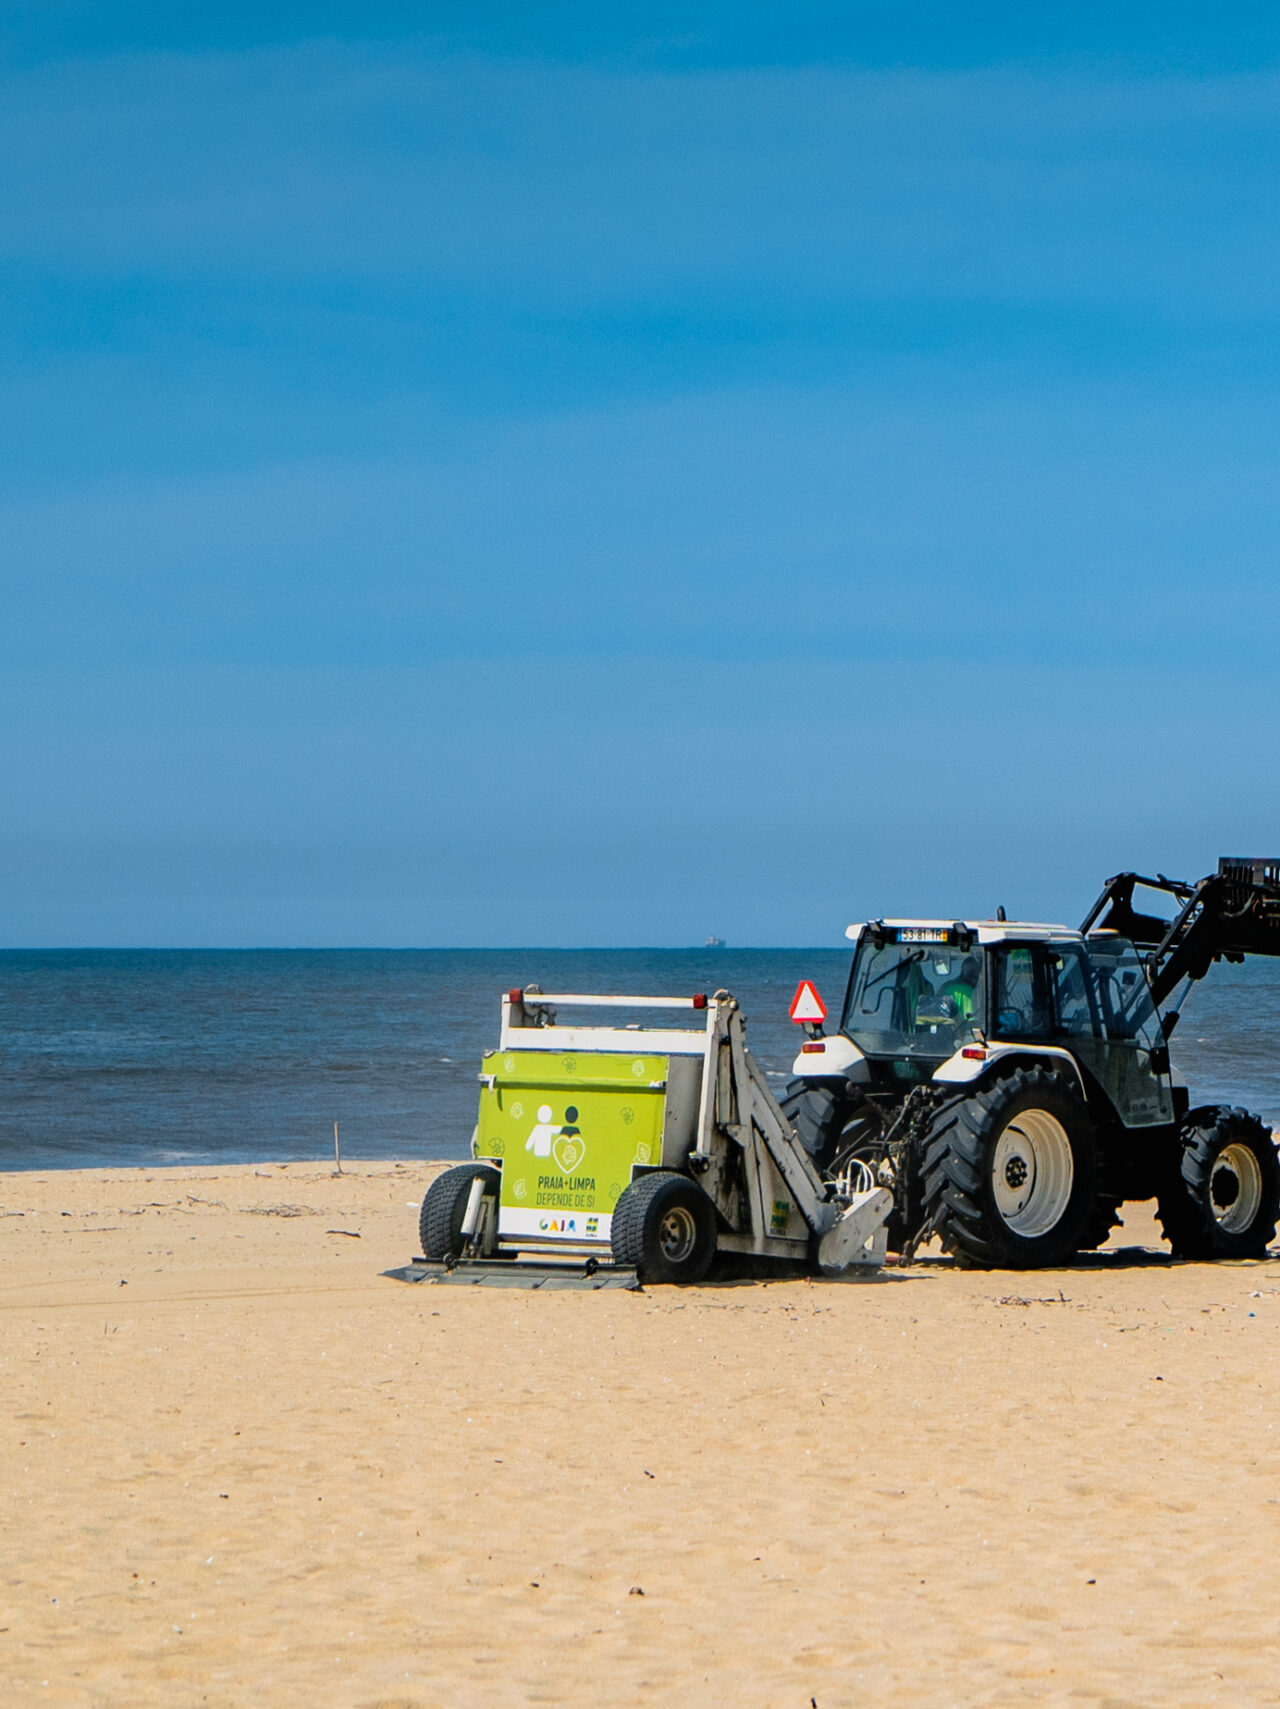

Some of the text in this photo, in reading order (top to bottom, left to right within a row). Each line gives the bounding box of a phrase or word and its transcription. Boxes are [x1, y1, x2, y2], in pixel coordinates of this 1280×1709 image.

[536, 1192, 595, 1208] DEPENDE DE SI
[539, 1218, 576, 1232] GAIA
